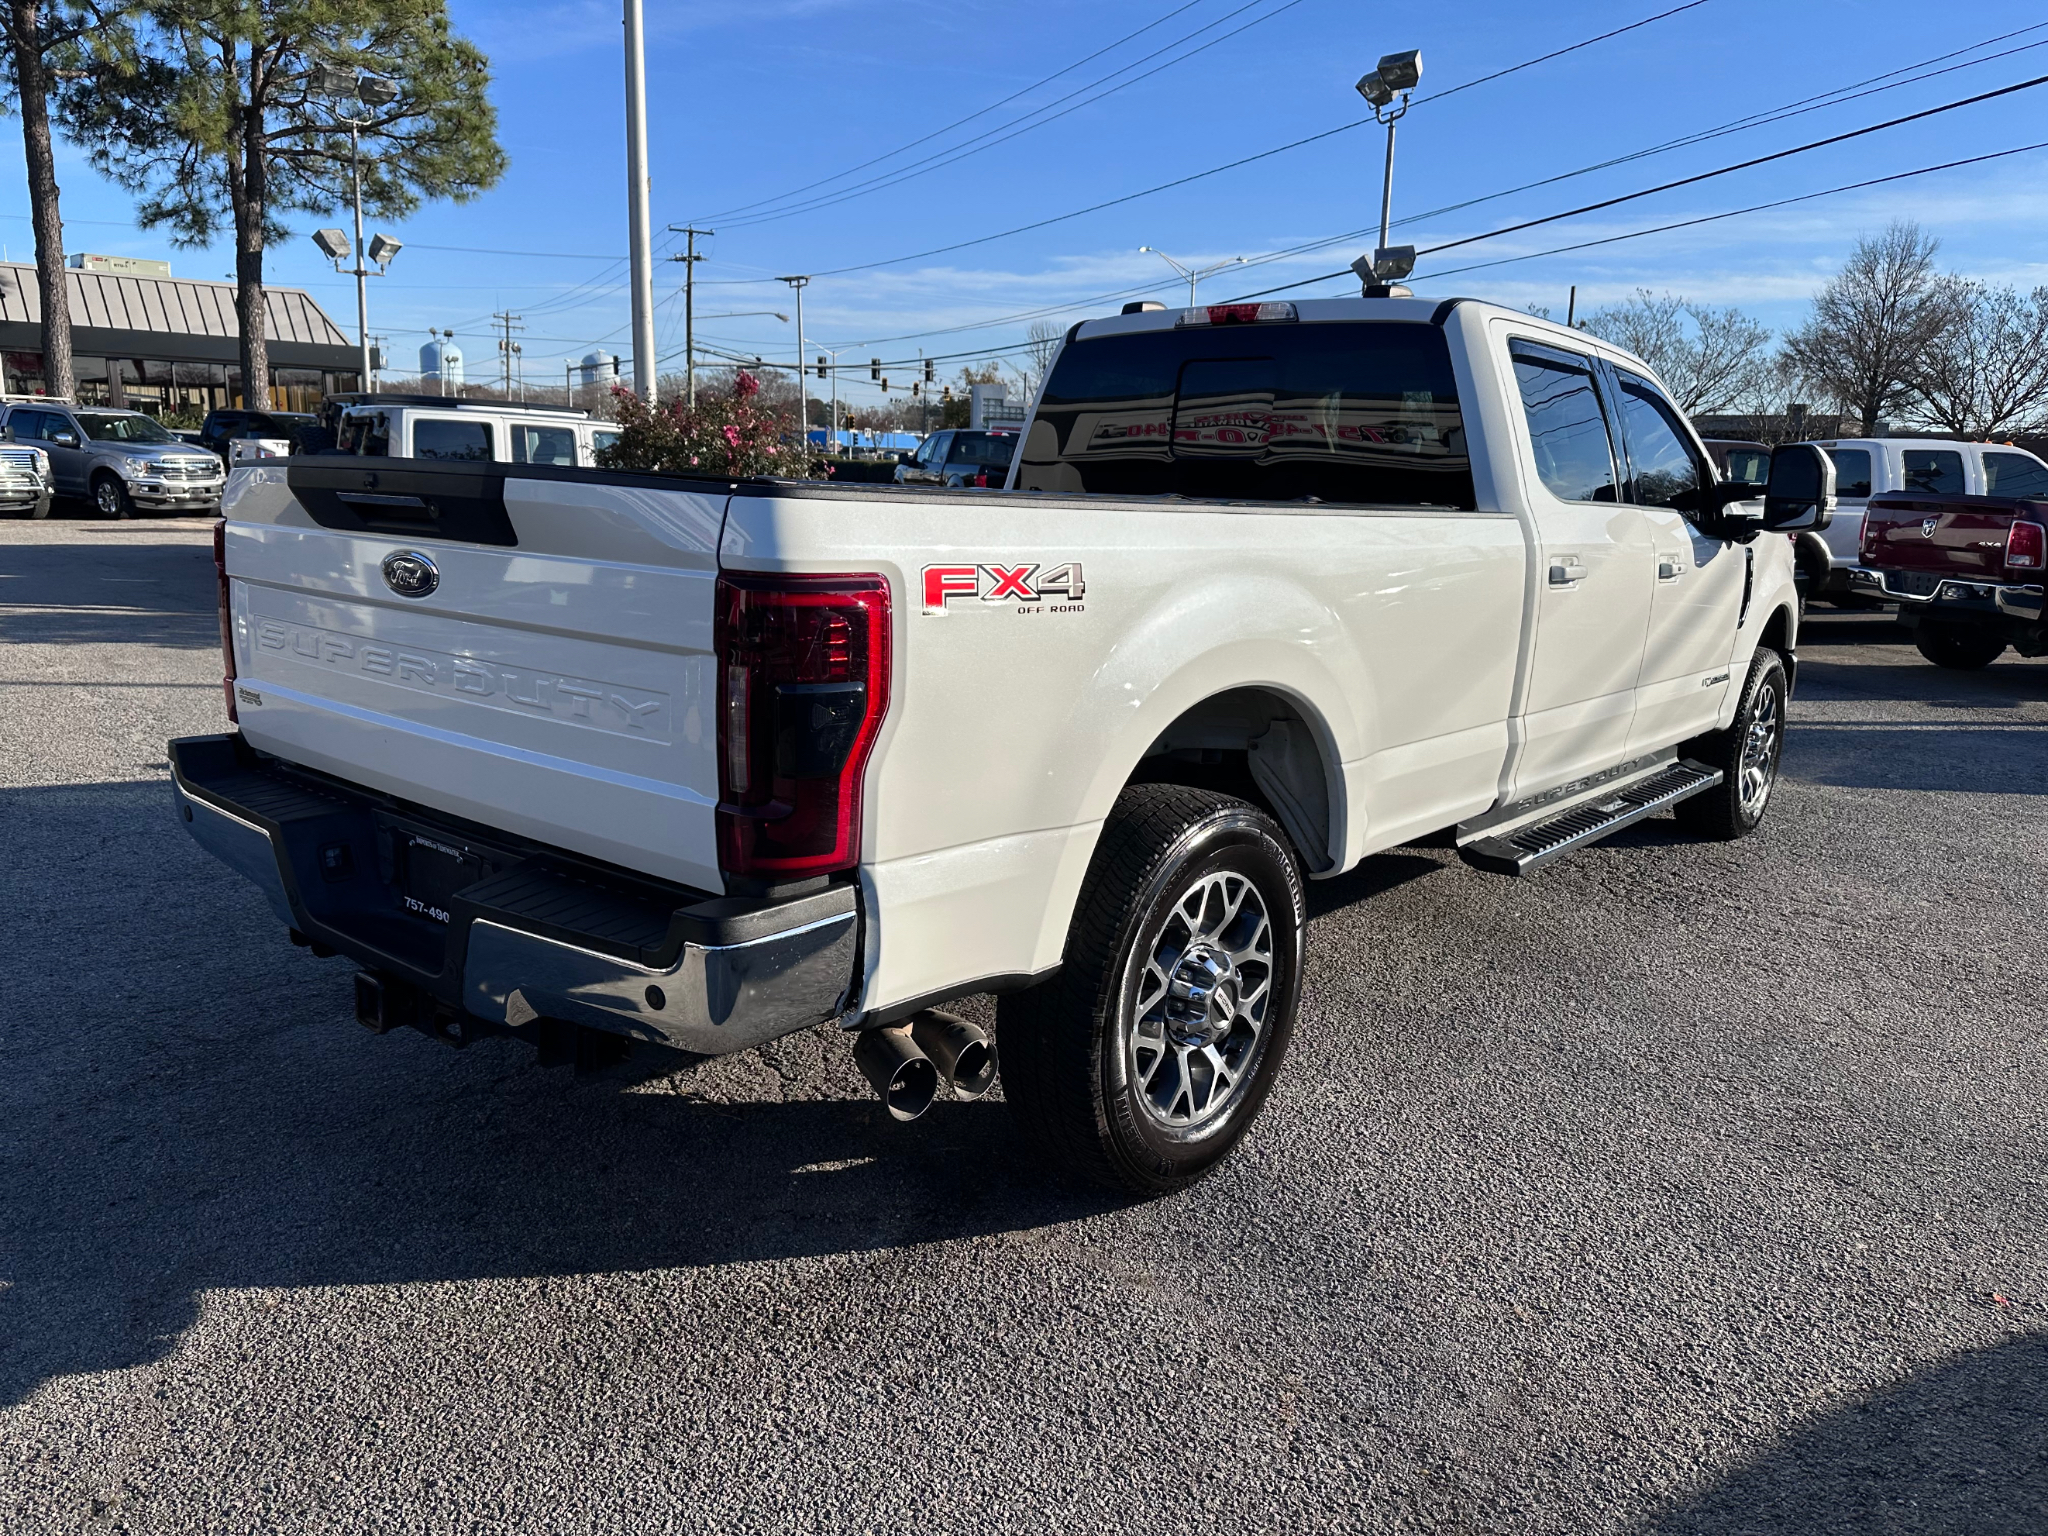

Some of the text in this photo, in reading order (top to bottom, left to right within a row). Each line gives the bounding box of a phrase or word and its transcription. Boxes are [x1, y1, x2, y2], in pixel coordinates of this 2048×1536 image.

[390, 560, 421, 587] Ford
[920, 562, 1086, 617] FX4
[1017, 604, 1085, 614] OFF ROAD
[260, 621, 661, 729] SUPER DUTY
[1517, 757, 1642, 811] SUPER DUTY
[404, 895, 450, 923] 757-490
[1217, 993, 1232, 1015] FORD
